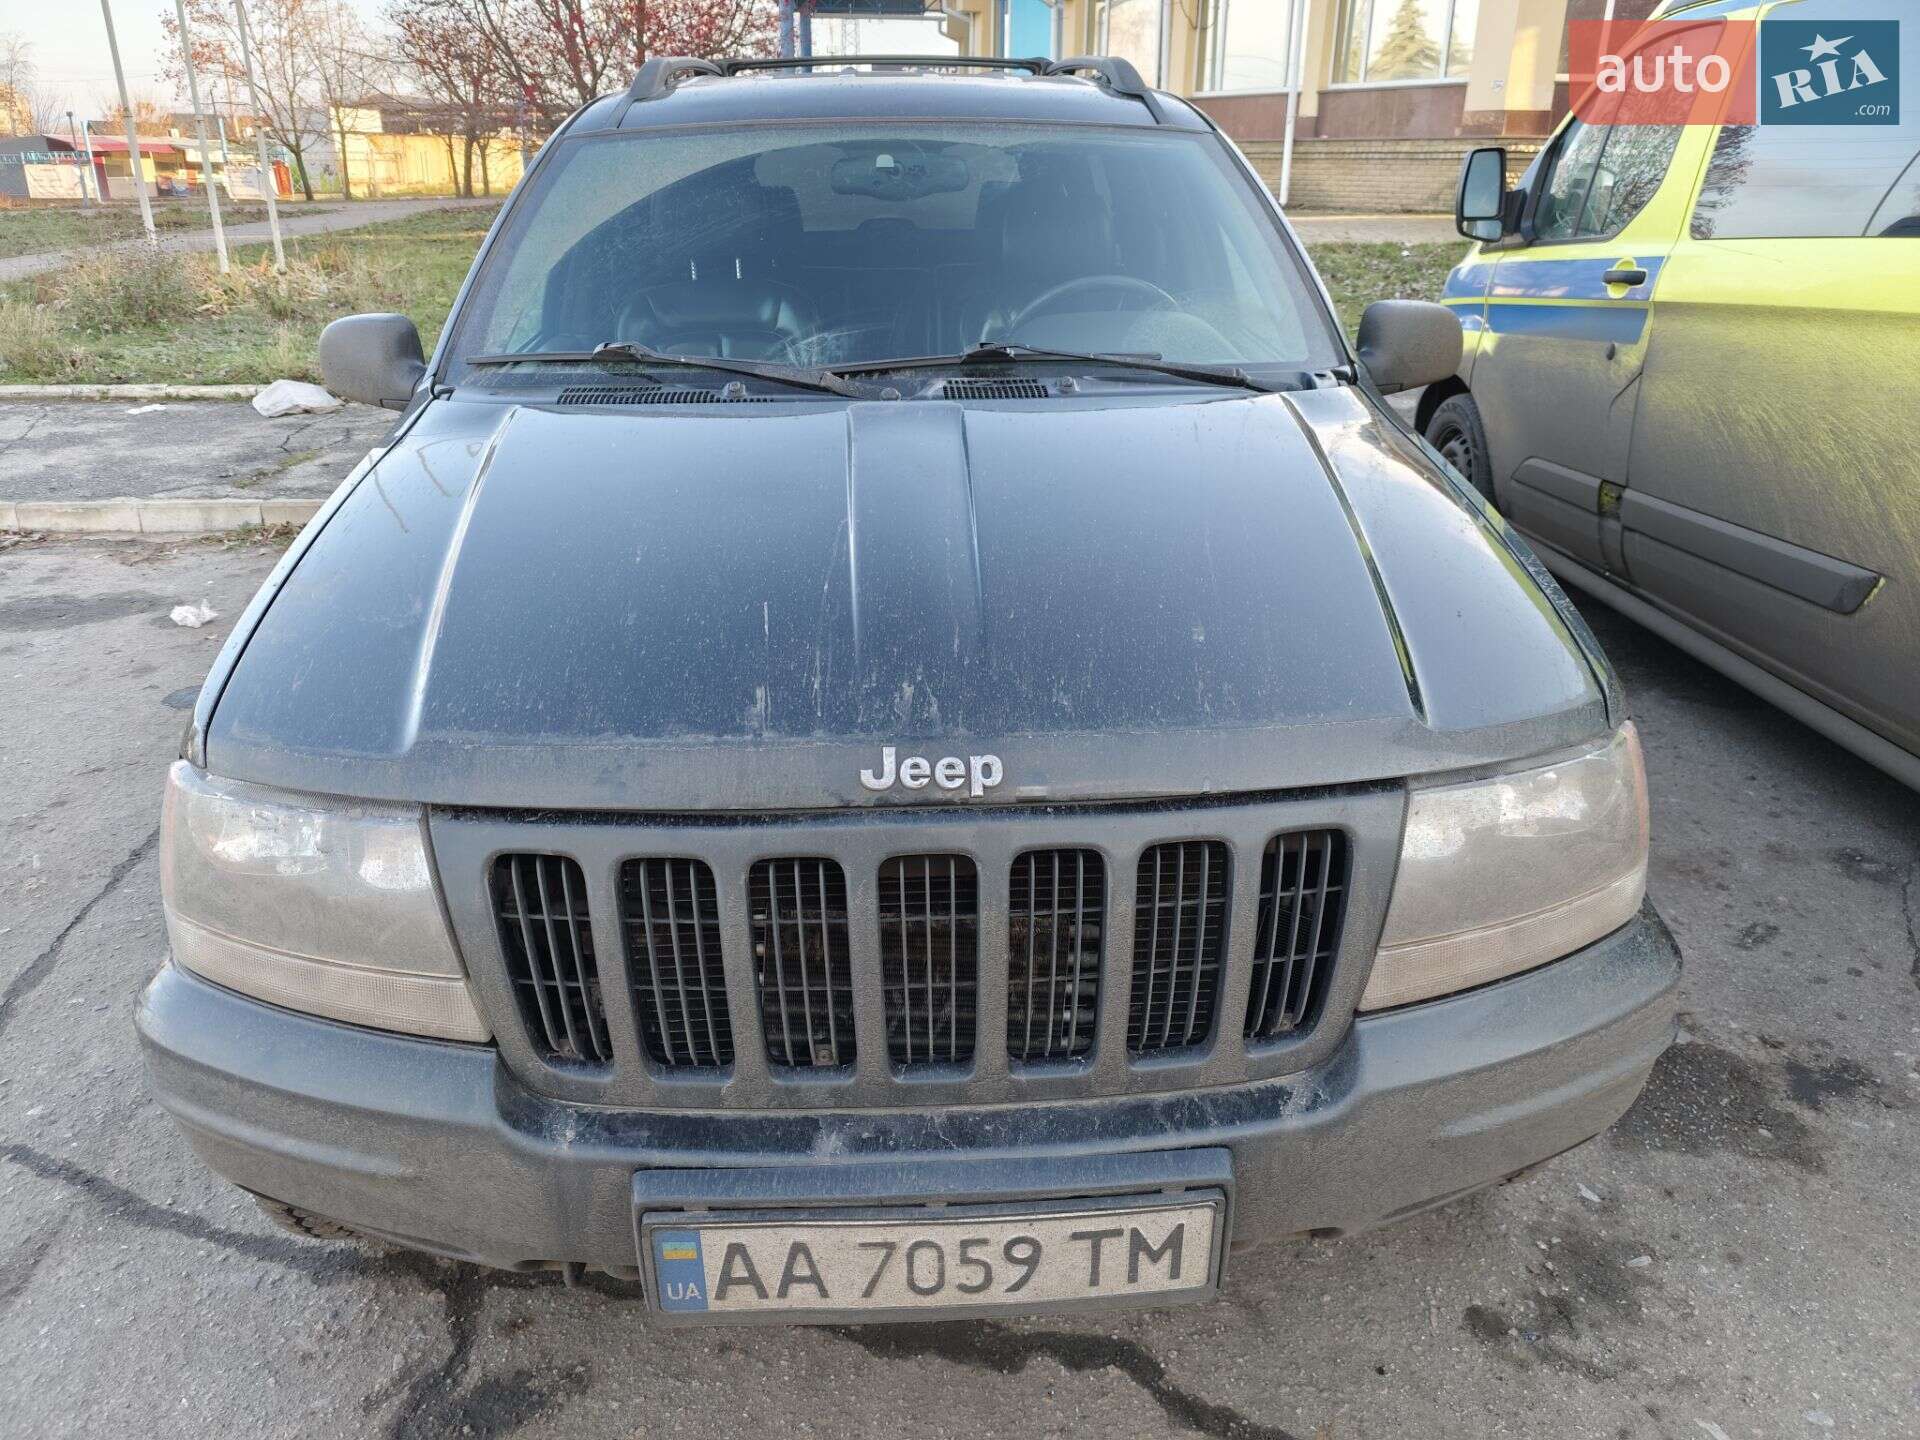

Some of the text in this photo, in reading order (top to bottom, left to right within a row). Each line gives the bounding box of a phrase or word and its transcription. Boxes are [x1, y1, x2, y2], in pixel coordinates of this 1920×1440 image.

[860, 747, 1003, 798] Jeep
[714, 1222, 1185, 1300] AA 7059 TM
[666, 1282, 702, 1300] UA
